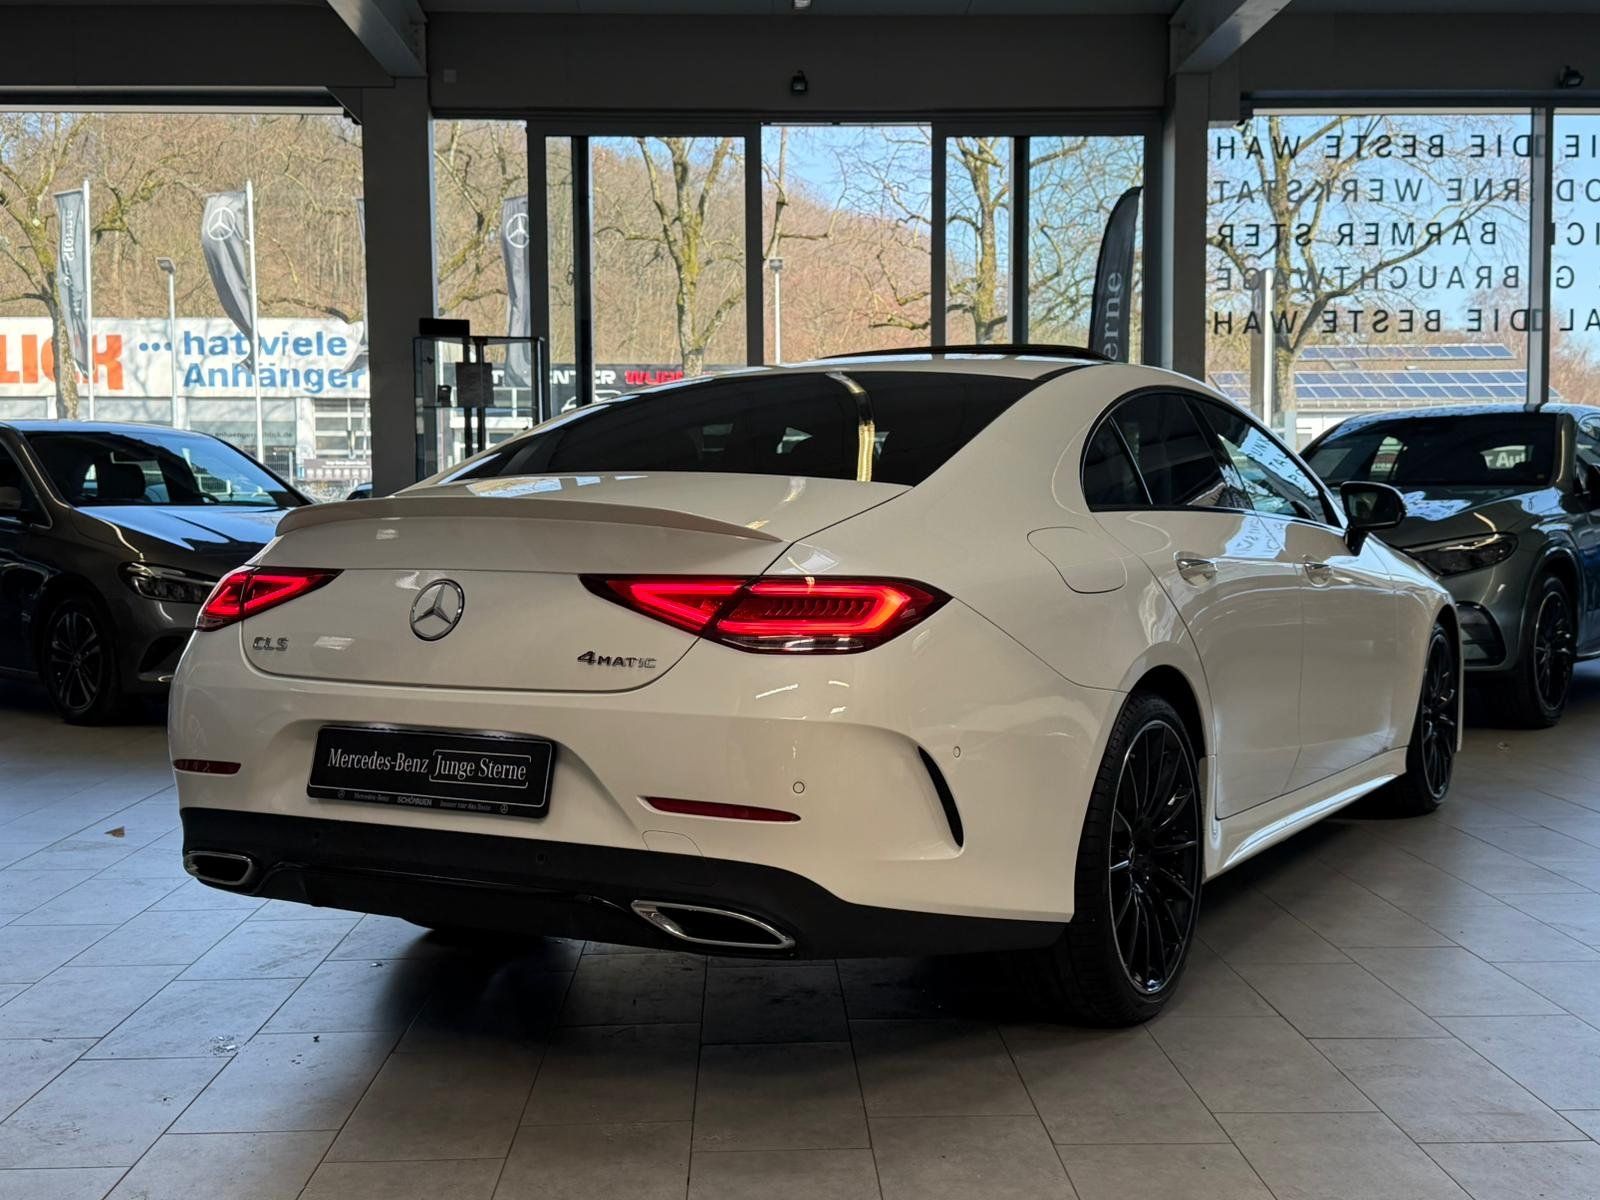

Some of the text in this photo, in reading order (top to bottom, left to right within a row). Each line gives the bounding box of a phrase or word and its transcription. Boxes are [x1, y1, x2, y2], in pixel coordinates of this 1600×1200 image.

[1103, 271, 1123, 361] erne
[183, 331, 249, 356] hat
[259, 331, 348, 356] viele
[182, 362, 367, 395] Anhänger
[251, 636, 289, 652] CLS
[576, 650, 658, 670] 4MATIC
[327, 748, 528, 781] Mercedes-Benz Junge Sterne
